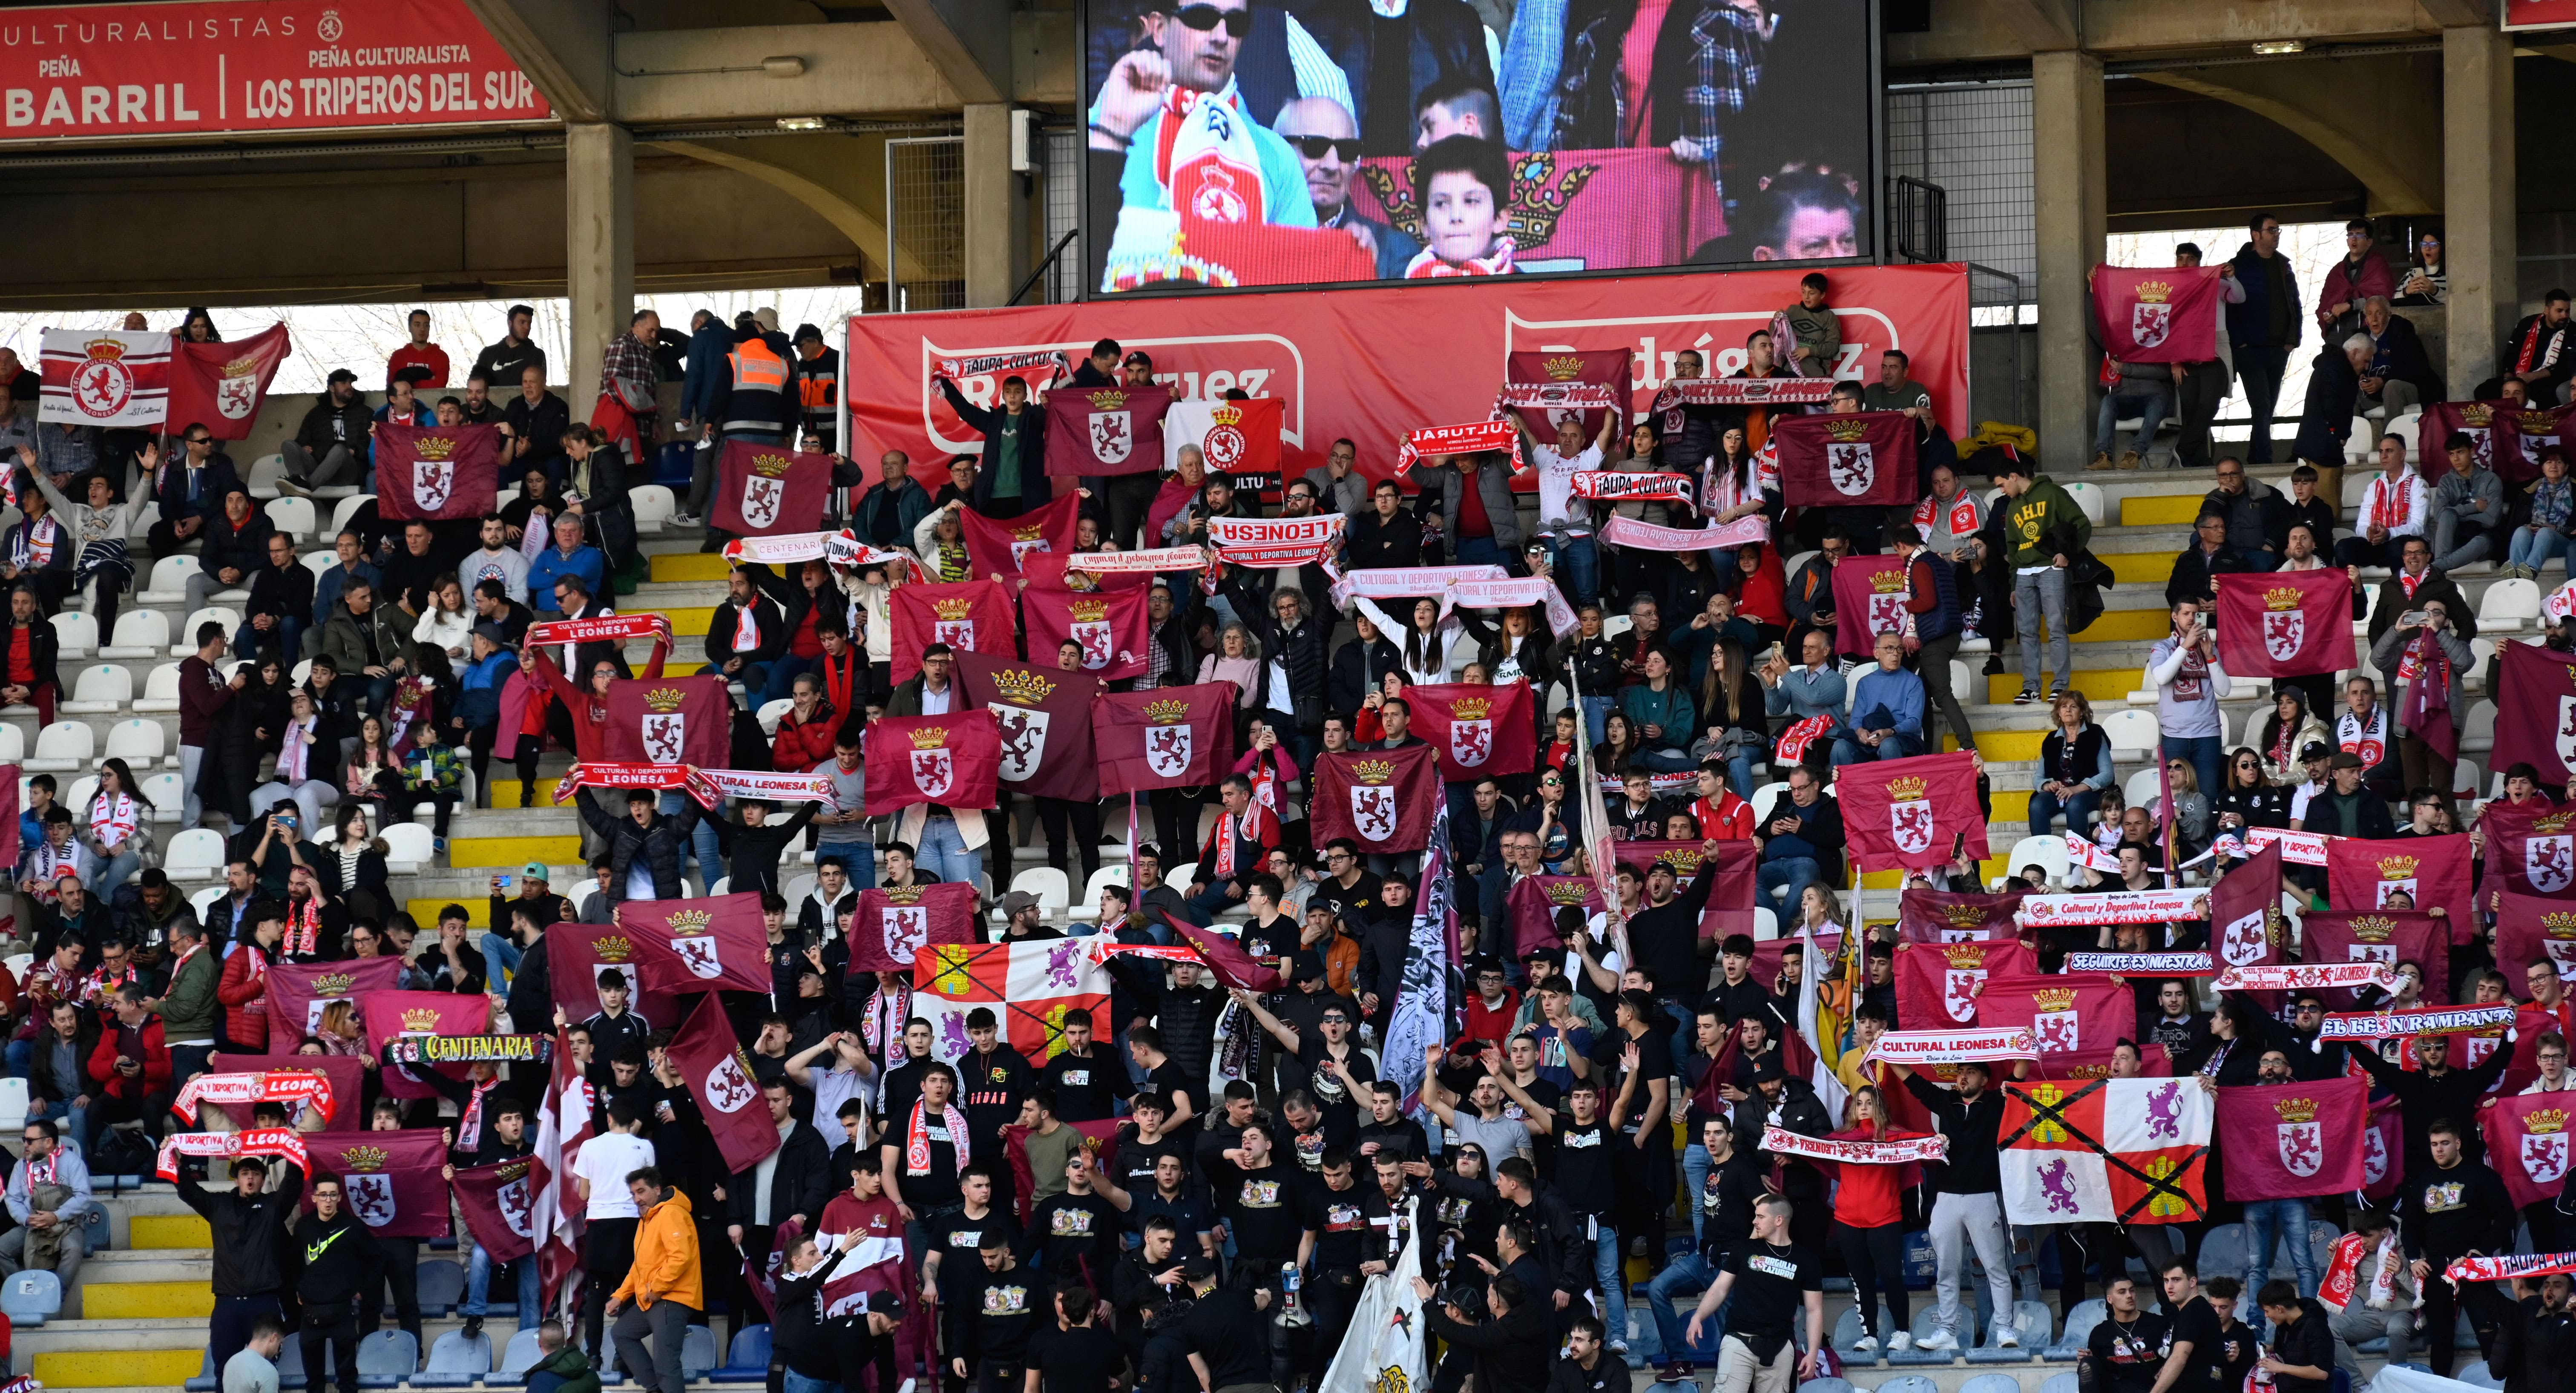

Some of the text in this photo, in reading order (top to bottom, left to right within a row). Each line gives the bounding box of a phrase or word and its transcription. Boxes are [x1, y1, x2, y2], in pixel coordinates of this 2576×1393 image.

[308, 44, 470, 68] PEÑA CULTURALISTA
[39, 54, 81, 78] PEÑA
[245, 70, 535, 118] LOS TRIPEROS DEL SUR
[6, 83, 199, 127] BARRIL
[1682, 383, 1745, 397] CULTURAL
[1223, 520, 1328, 541] LEONESA
[1260, 550, 1293, 560] DEPORTIVA
[1294, 547, 1320, 557] LEONESA
[1360, 573, 1398, 585] CULTURAL
[1490, 583, 1531, 596] DEPORTIVA
[557, 620, 595, 630] CULTURAL
[602, 617, 643, 626] DEPORTIVA
[570, 624, 631, 638] LEONESA
[604, 775, 666, 784] LEONESA
[755, 779, 808, 790] LEONESA
[2289, 841, 2326, 856] DEPORTIVA
[2061, 900, 2184, 915] Cultural y Deportiva Leonesa
[2072, 953, 2131, 970] SEGUIRTE
[2243, 966, 2283, 975] CULTURAL
[2334, 965, 2372, 982] LEONESA
[2243, 980, 2284, 989] DEPORTIVA
[1882, 1038, 2007, 1052] CULTURAL LEONESA
[212, 1083, 248, 1094] DEPORTIVA
[1129, 1168, 1156, 1178] ellesse
